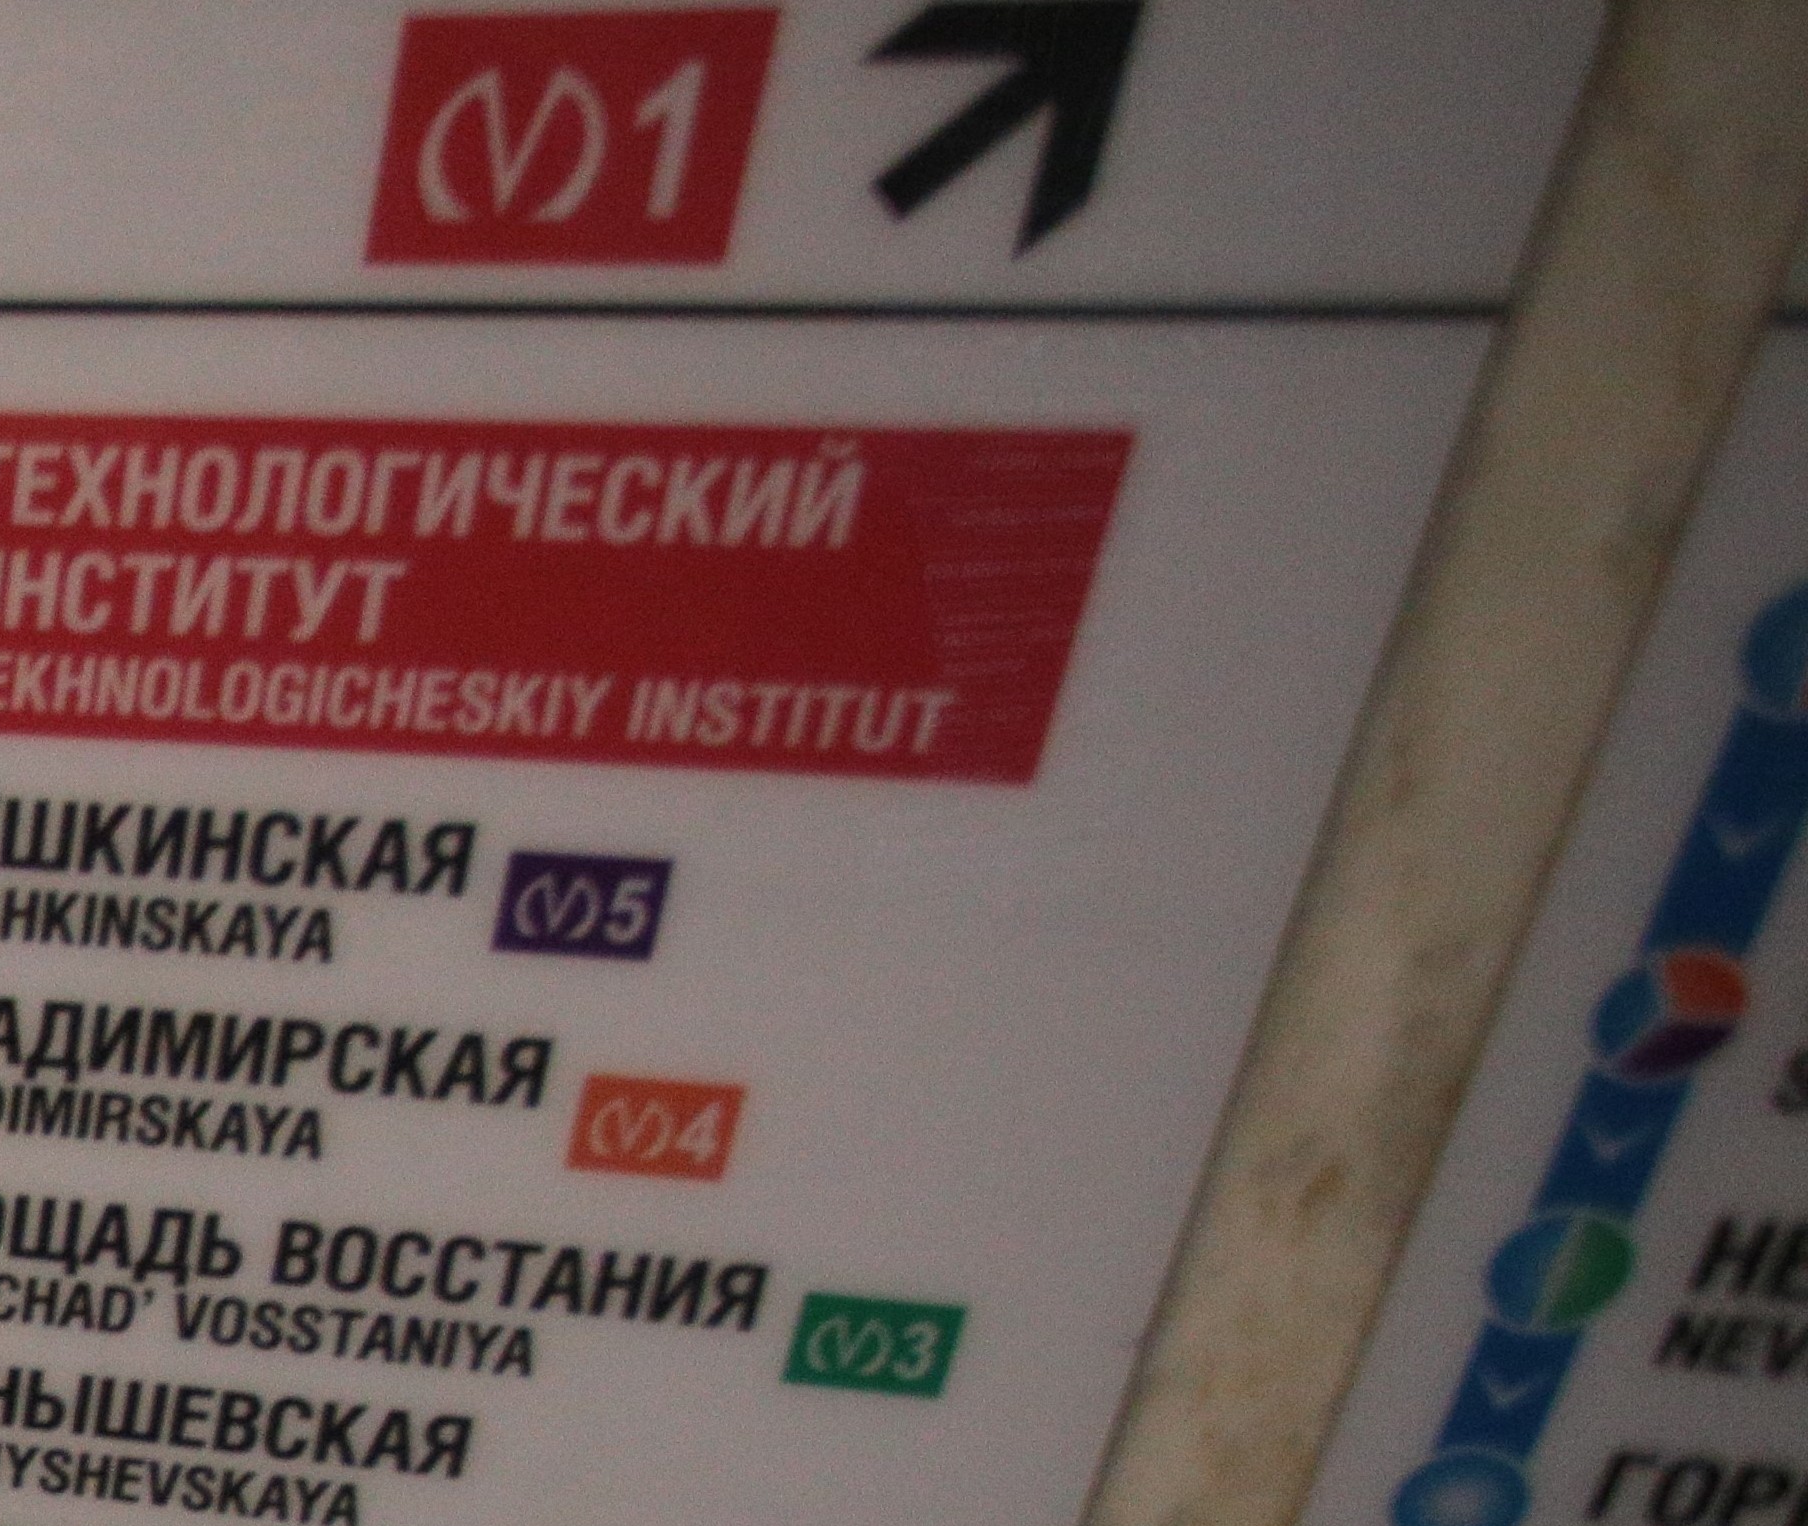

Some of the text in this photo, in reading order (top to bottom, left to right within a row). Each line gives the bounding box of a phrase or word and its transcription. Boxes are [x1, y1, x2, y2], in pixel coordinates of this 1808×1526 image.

[624, 680, 956, 757] INSTITUT
[272, 1220, 770, 1333] ВОССТАНИЯ
[173, 1292, 537, 1379] VOSSTANIYA
